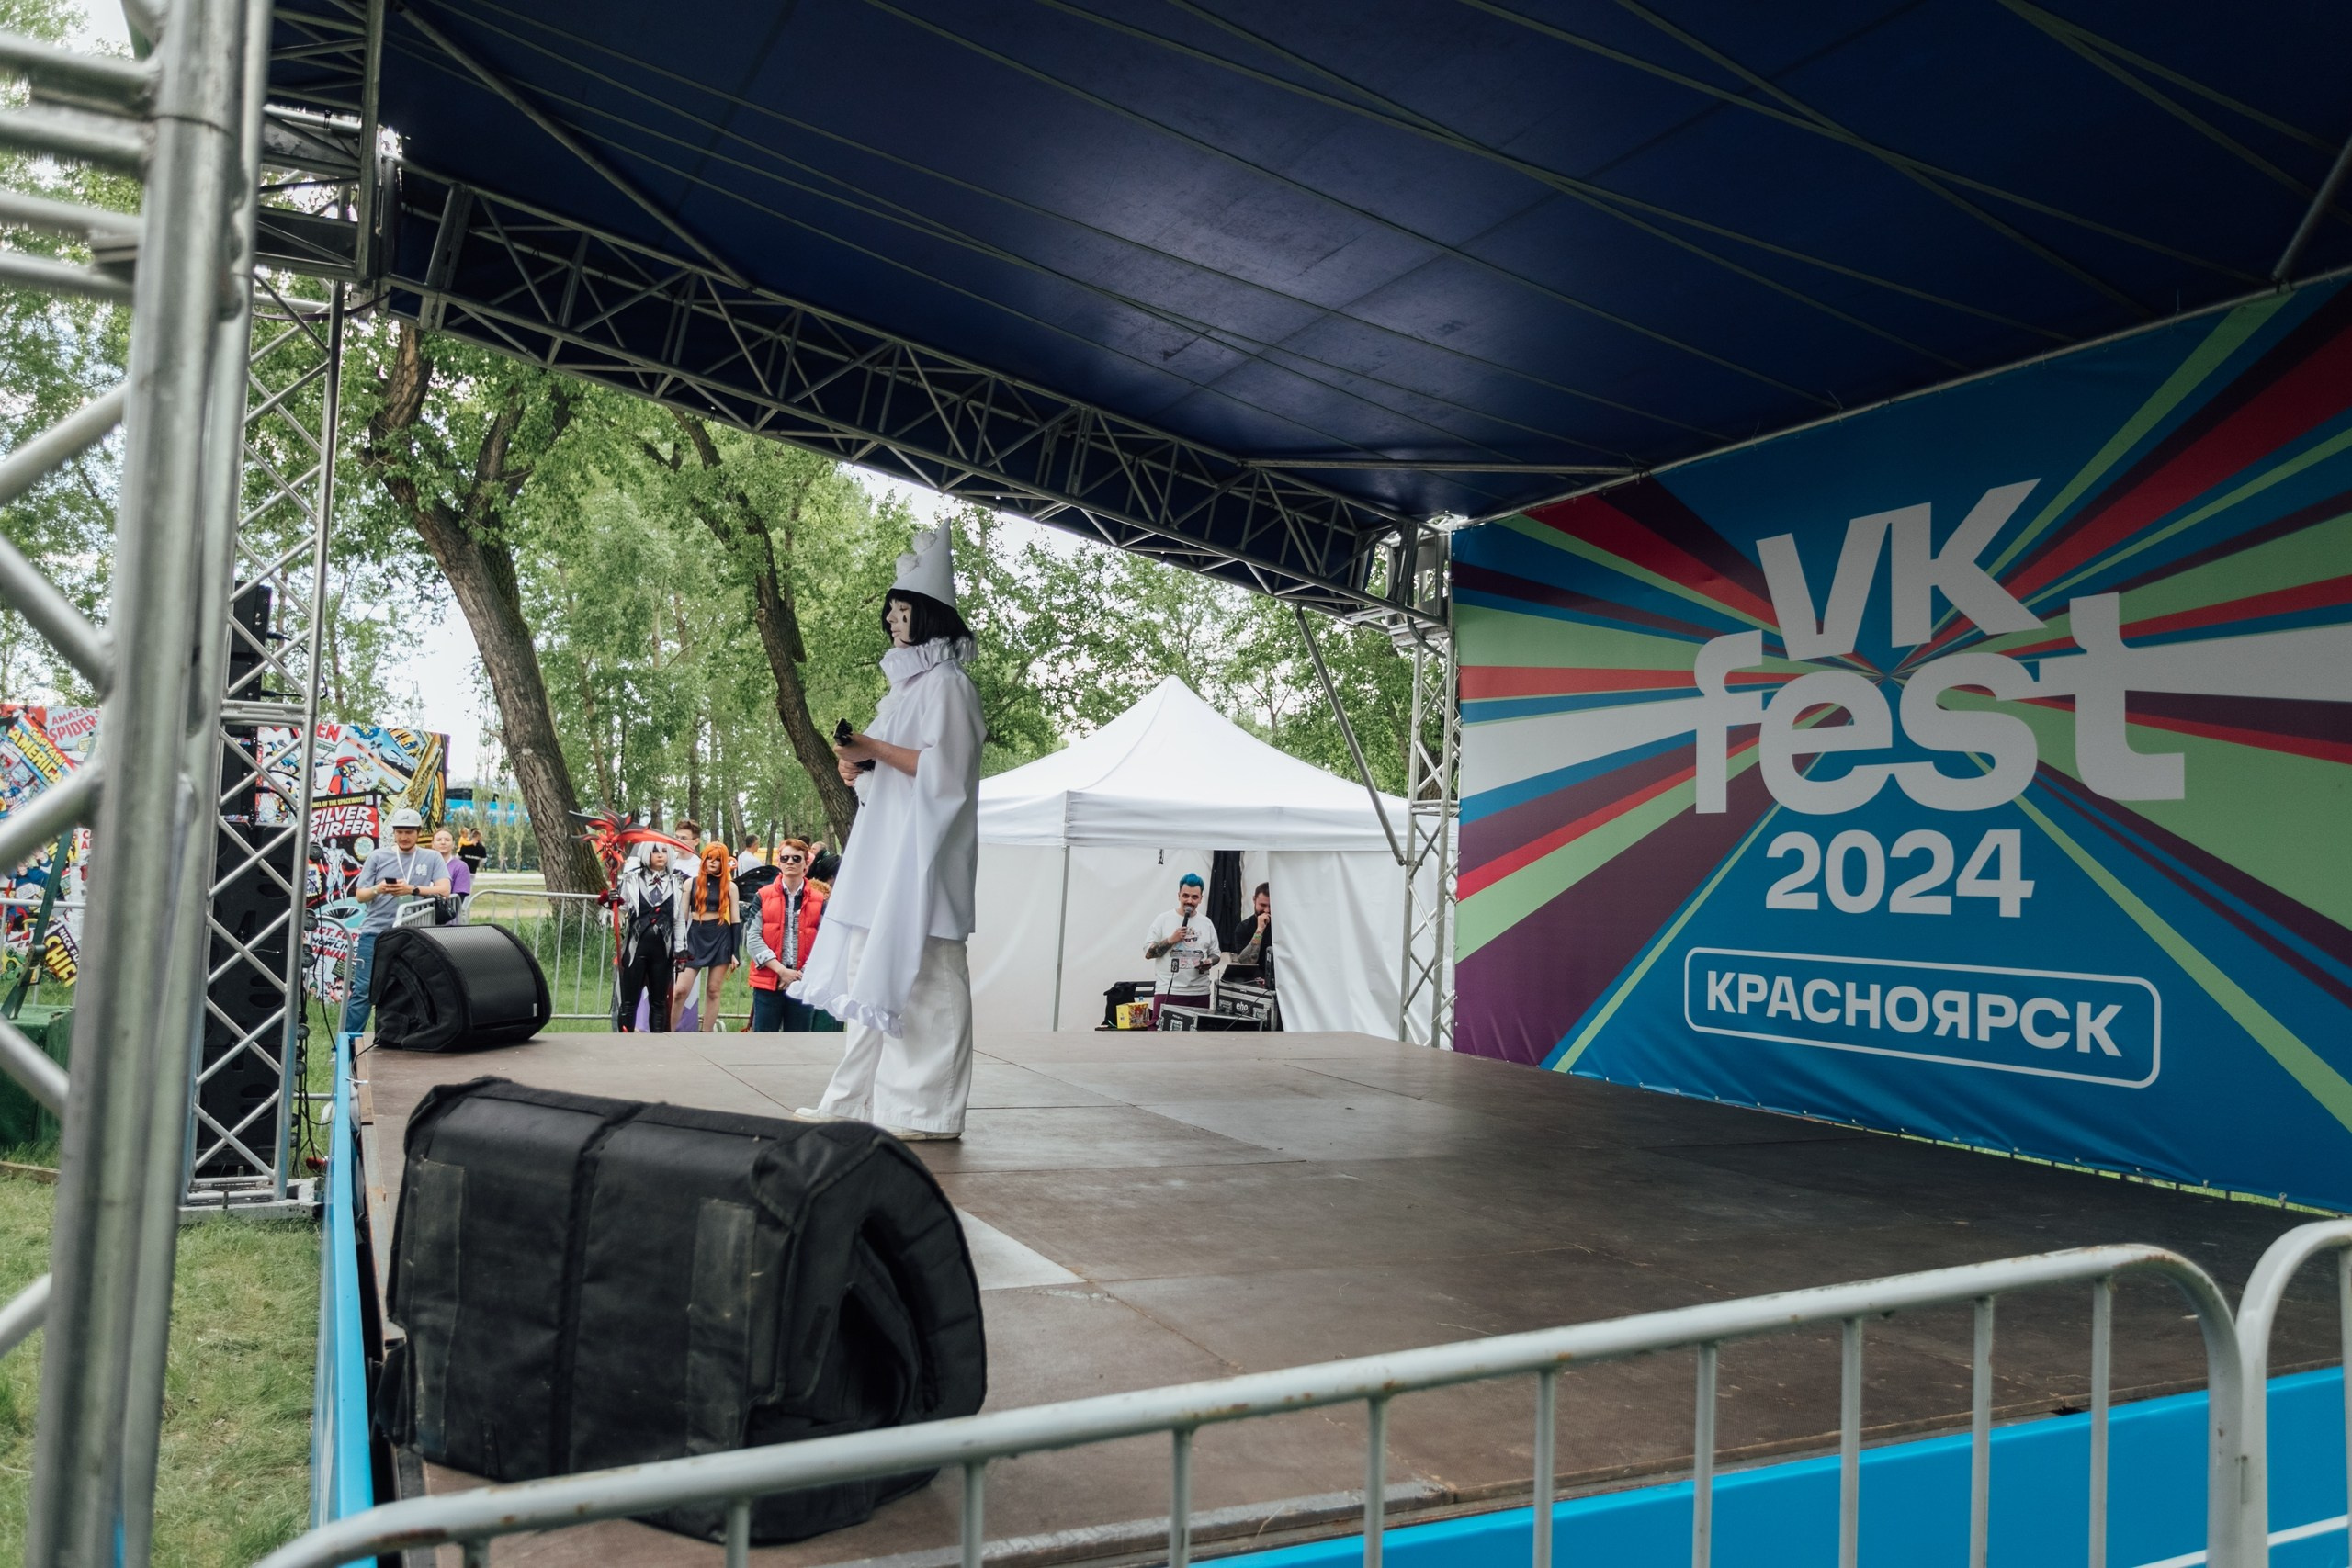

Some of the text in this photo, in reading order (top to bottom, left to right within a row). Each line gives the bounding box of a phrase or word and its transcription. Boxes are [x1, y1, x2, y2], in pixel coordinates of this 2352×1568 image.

[1756, 478, 2048, 661] VK
[1694, 592, 2185, 815] fest
[7, 728, 63, 784] AMERICA
[28, 726, 66, 767] CAPTAIN
[310, 819, 375, 842] SURFER
[311, 806, 372, 827] SILVER
[1766, 829, 2035, 917] 2024
[58, 927, 74, 950] NICK
[1707, 970, 2123, 1057] КРАСНОЯРСК
